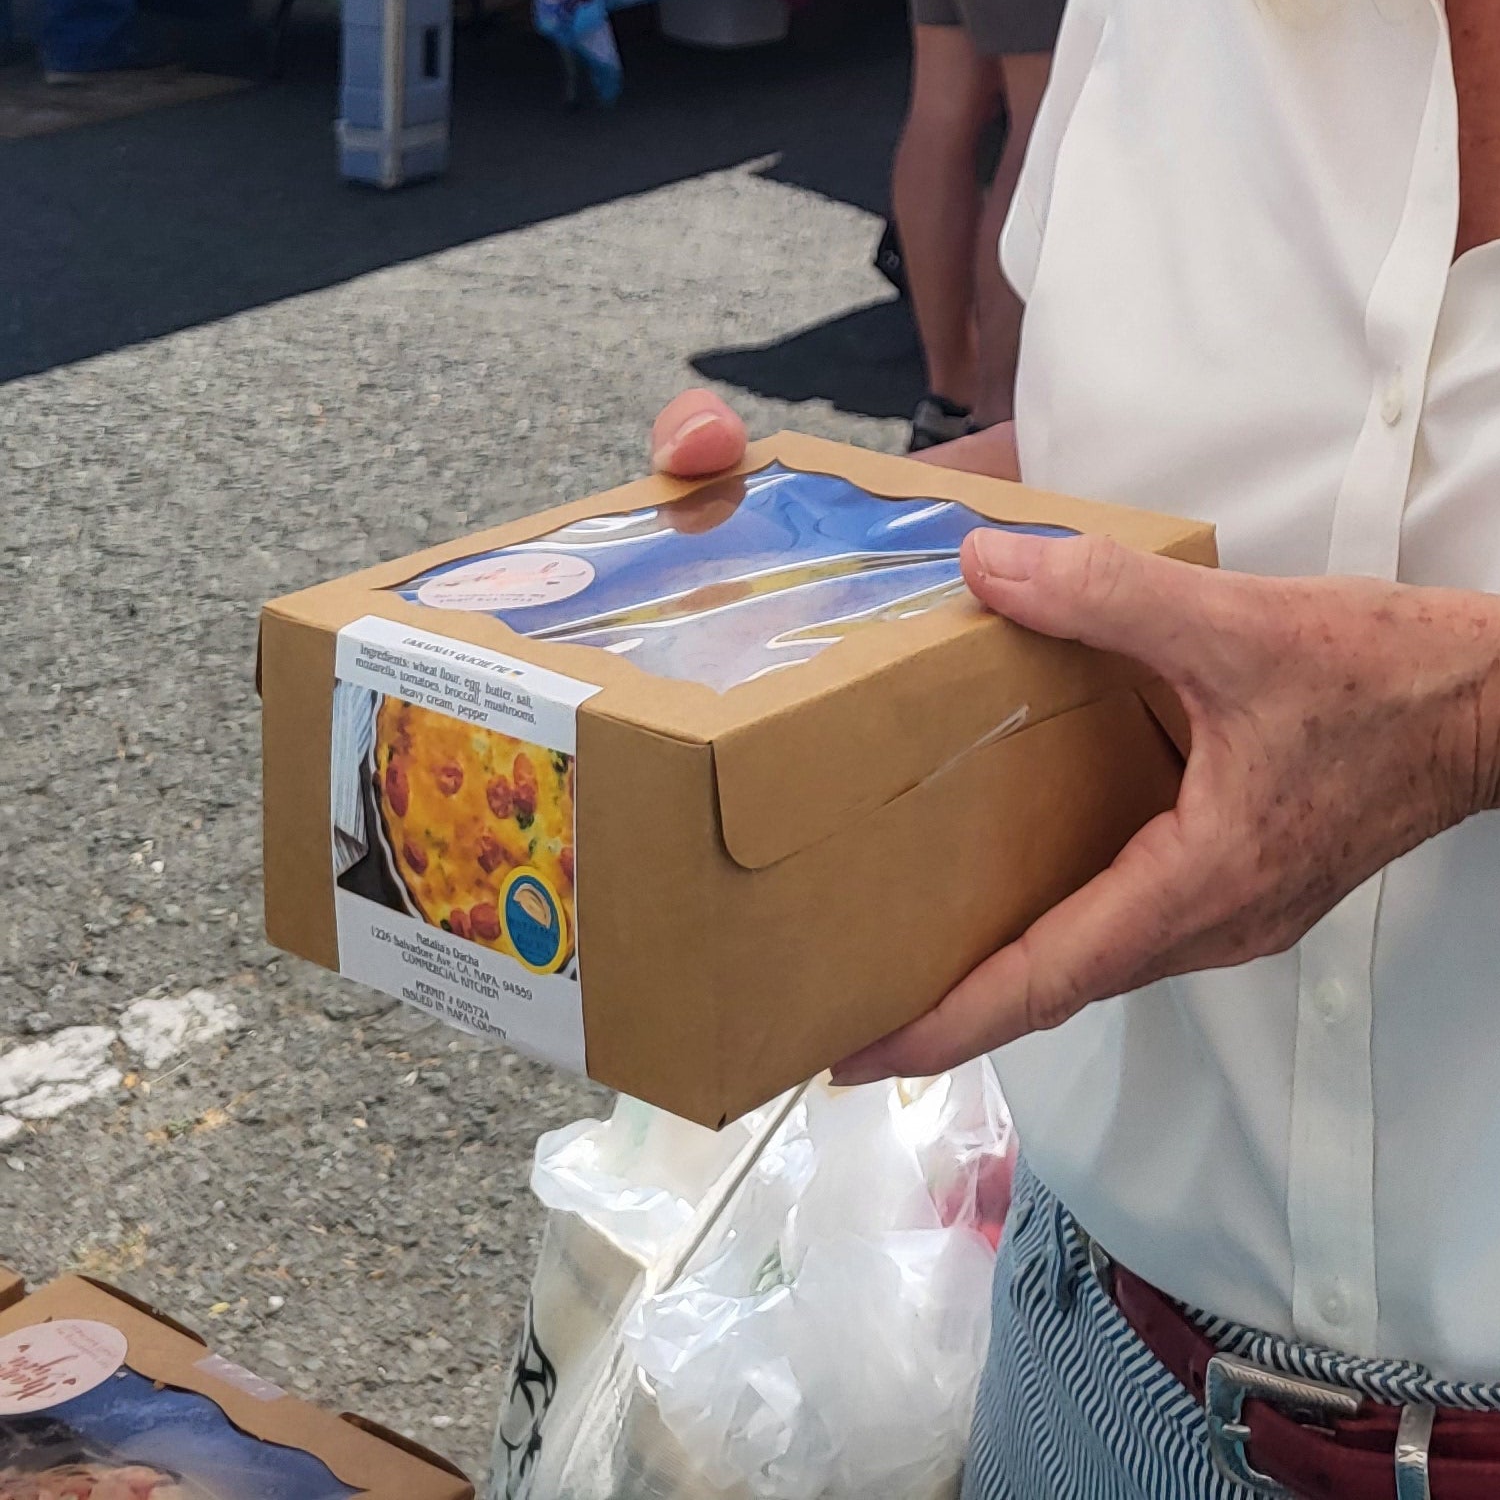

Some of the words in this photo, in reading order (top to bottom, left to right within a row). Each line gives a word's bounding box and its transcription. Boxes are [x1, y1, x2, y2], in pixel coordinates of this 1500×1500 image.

[412, 661, 437, 677] wheat
[400, 684, 424, 703] heavy
[457, 704, 489, 722] pepper
[452, 947, 480, 967] Dacha
[415, 979, 446, 1002] PERMIT
[460, 975, 500, 1001] KITCHEN
[402, 986, 433, 1009] ISSUED
[446, 1005, 470, 1024] NAPA
[471, 1016, 507, 1040] COUNTY
